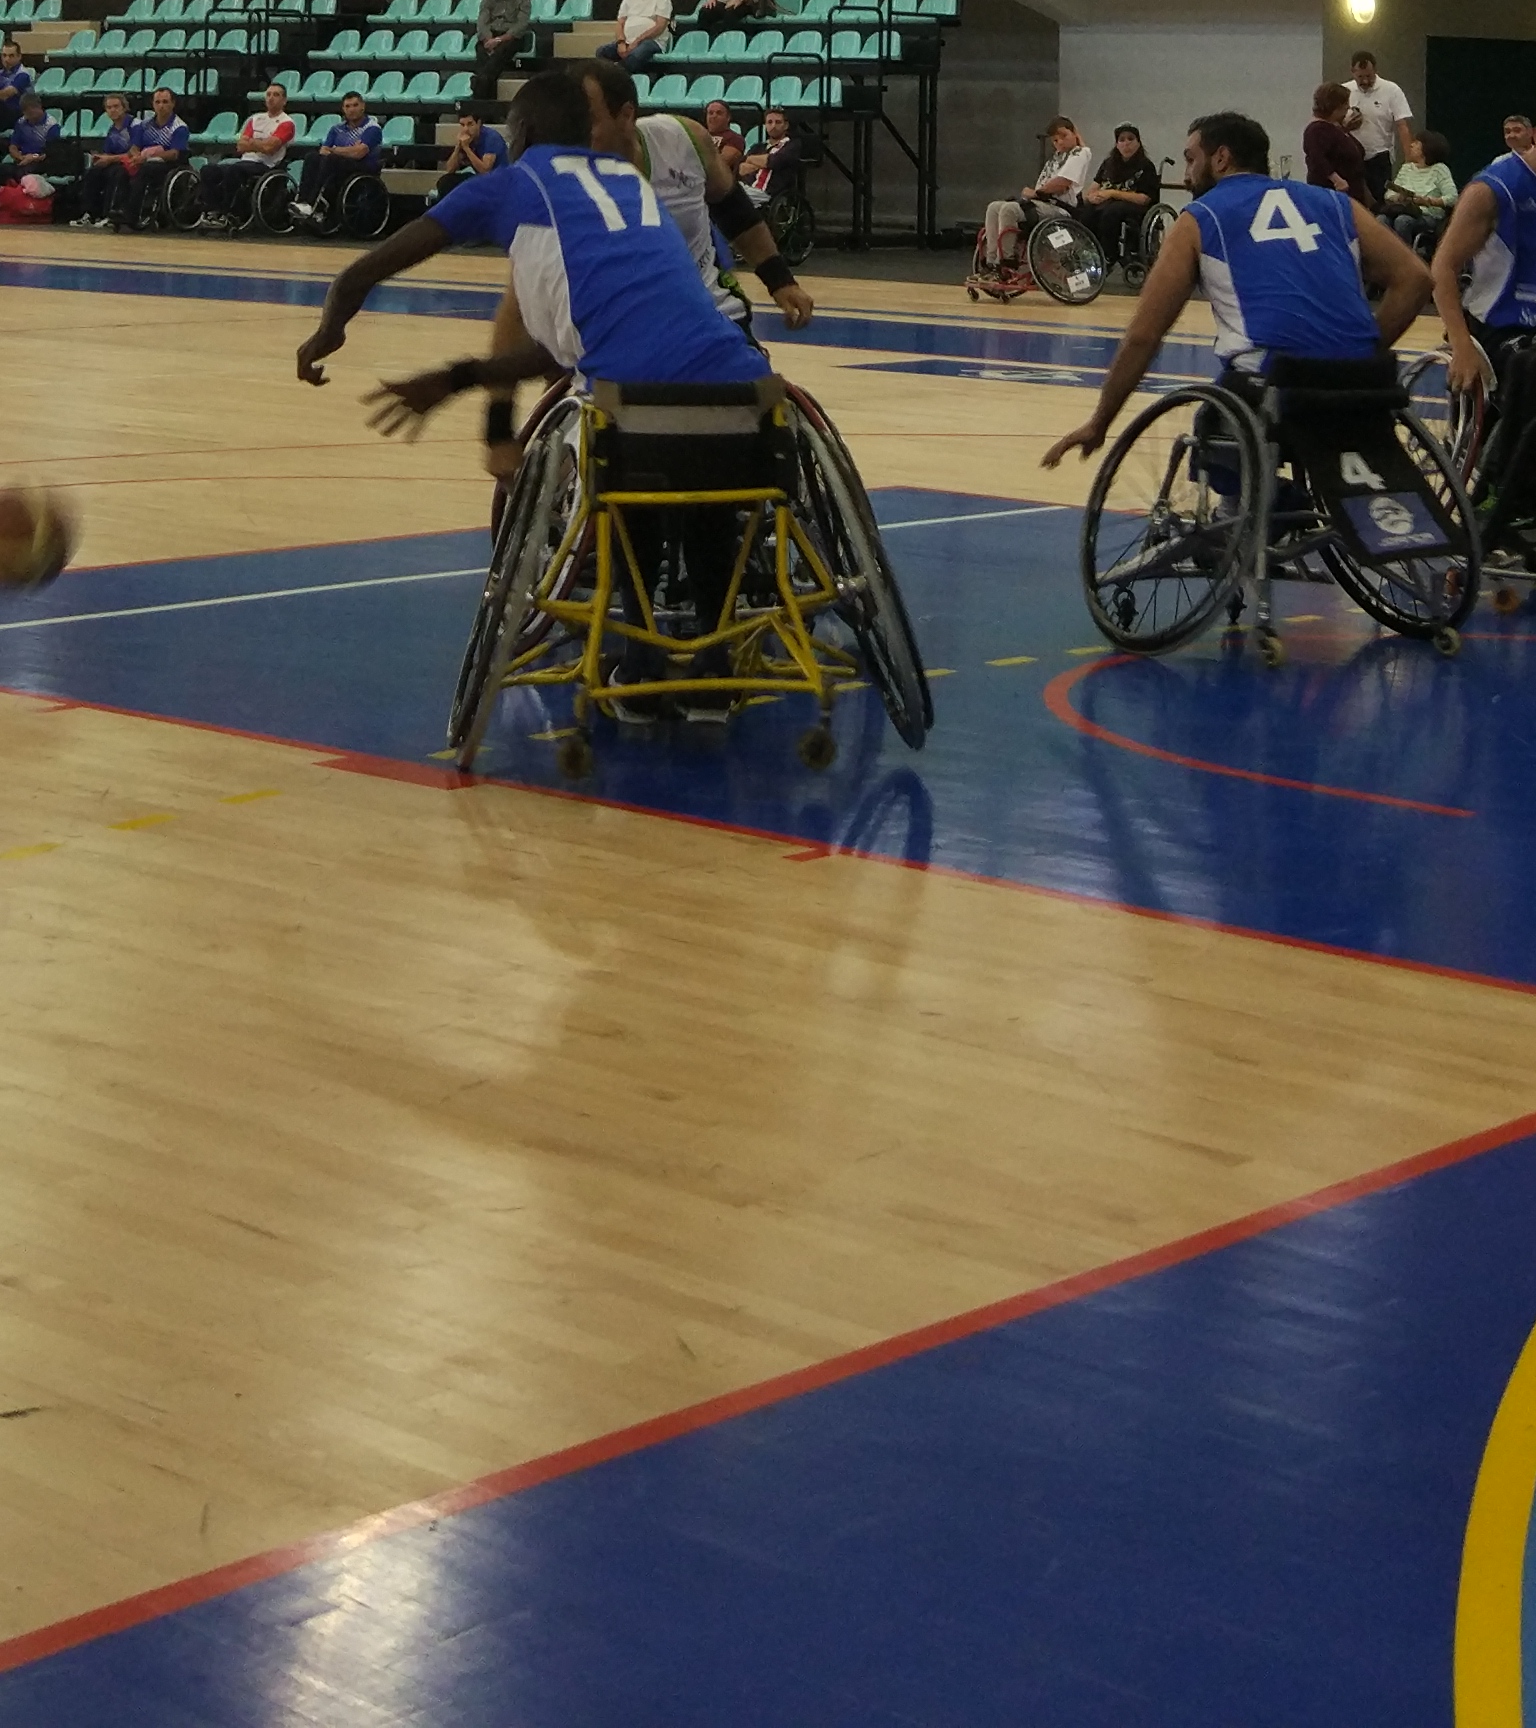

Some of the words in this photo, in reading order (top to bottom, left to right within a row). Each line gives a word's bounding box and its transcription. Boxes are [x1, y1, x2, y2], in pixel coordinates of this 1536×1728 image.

[550, 154, 662, 232] 17
[1249, 187, 1323, 253] 4
[1340, 451, 1388, 491] 4
